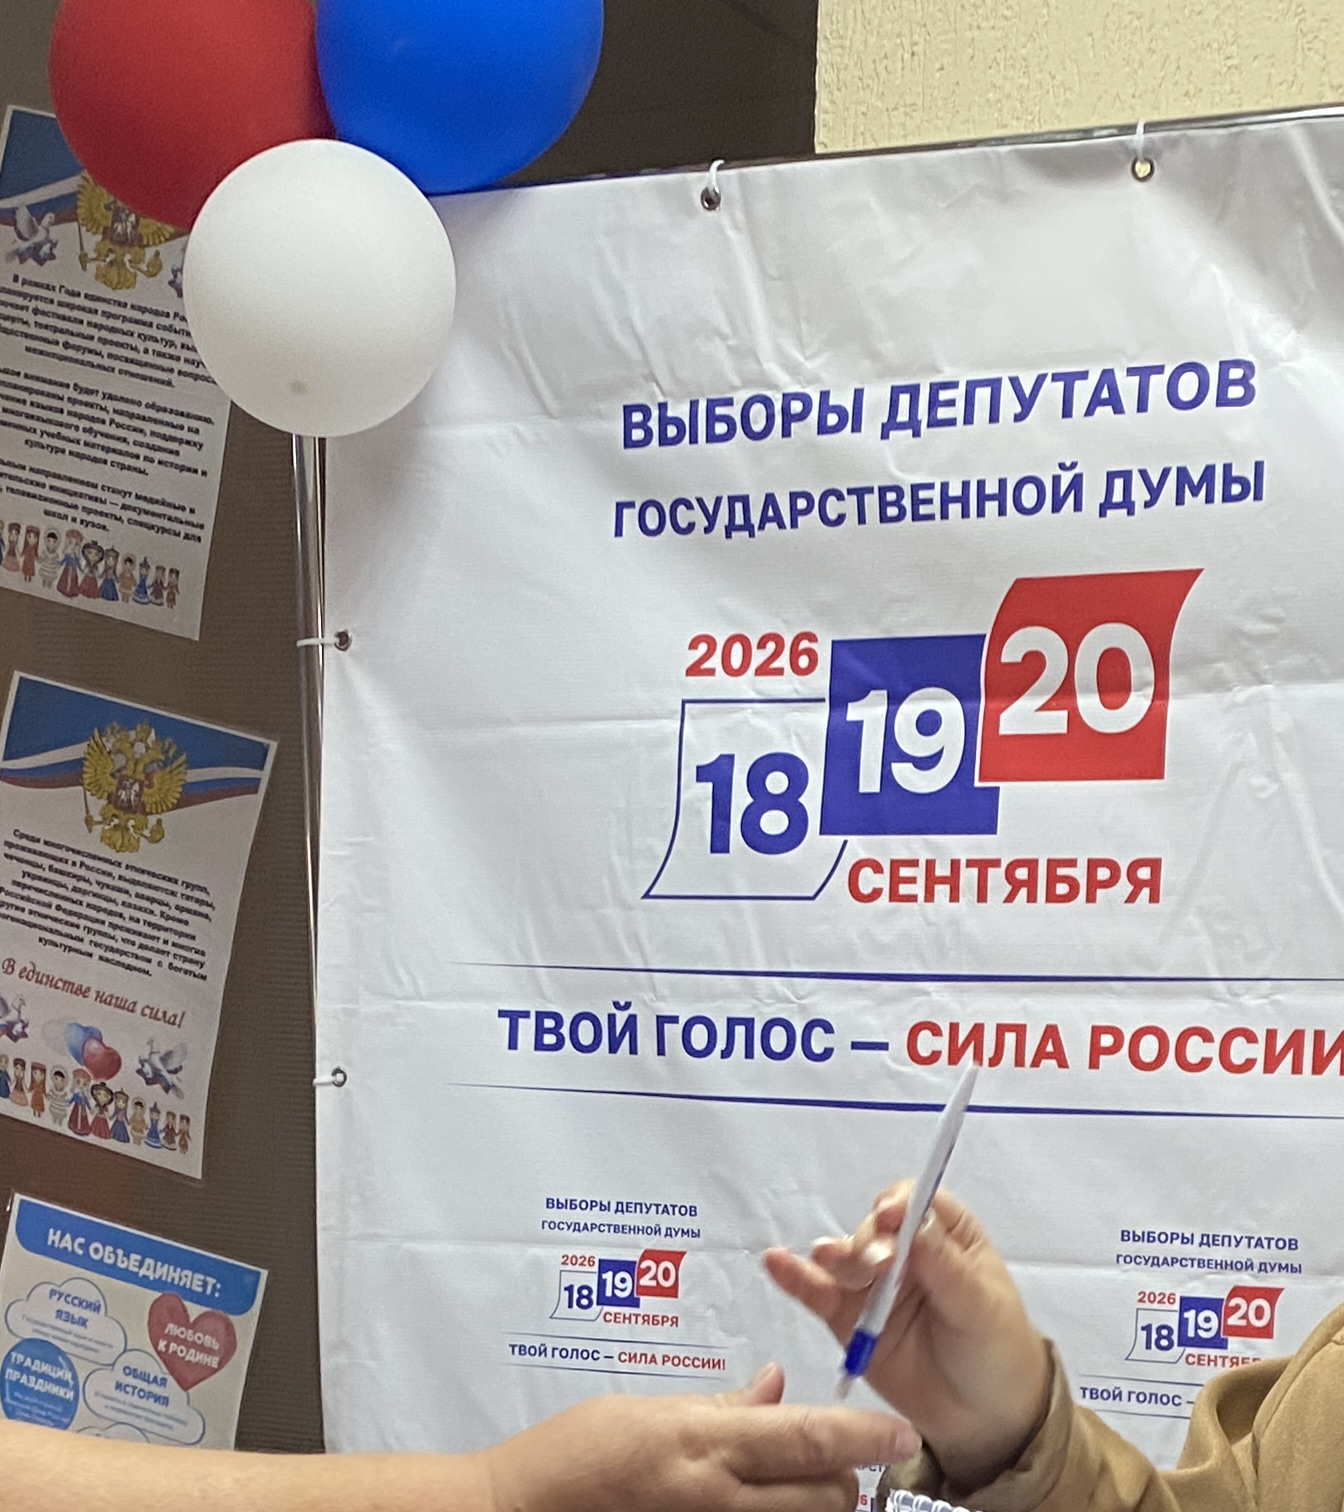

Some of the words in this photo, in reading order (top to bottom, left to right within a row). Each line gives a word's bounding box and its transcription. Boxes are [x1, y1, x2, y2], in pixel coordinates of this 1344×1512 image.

[622, 388, 863, 449] ВЫБОРЫ
[881, 359, 1256, 440] ДЕПУТАТОВ
[614, 462, 1085, 539] ГОСУДАРСТВЕННОЙ
[1099, 461, 1264, 518] ДУМЫ
[685, 632, 819, 677] 2026
[696, 753, 809, 854] 18
[847, 687, 965, 794] 19
[999, 622, 1155, 735] 20
[848, 857, 1162, 904] СЕНТЯБРЯ
[2, 958, 16, 975] В
[19, 961, 91, 998] единстве
[95, 989, 137, 1013] наша
[141, 1005, 186, 1028] сила!
[498, 1000, 638, 1055] ТВОЙ
[656, 1014, 835, 1063] ГОЛОС
[906, 1021, 1070, 1071] СИЛА
[546, 1198, 610, 1212] ВЫБОРЫ
[615, 1201, 697, 1217] ДЕПУТАТОВ
[541, 1220, 661, 1236] ГОСУДАРСТВЕННОЙ
[664, 1227, 701, 1239] ДУМЫ
[1120, 1229, 1194, 1246] ВЫБОРЫ
[1199, 1233, 1299, 1250] ДЕПУТАТОВ
[47, 1227, 85, 1255] НАС
[89, 1242, 222, 1298] ОБЪЕДИНЯЕТ:
[561, 1254, 596, 1267] 2026
[1116, 1254, 1254, 1272] ГОСУДАРСТВЕННОЙ
[1257, 1261, 1302, 1274] ДУМЫ
[564, 1284, 594, 1310] 18
[602, 1270, 633, 1298] 19
[639, 1259, 676, 1287] 20
[1137, 1291, 1176, 1305] 2026
[49, 1288, 101, 1314] РУССКИЙ
[55, 1309, 88, 1328] ЯЗЫК
[603, 1311, 679, 1328] СЕНТЯБРЯ
[1141, 1323, 1174, 1351] 18
[1183, 1309, 1219, 1339] 19
[1227, 1297, 1271, 1328] 20
[165, 1323, 220, 1349] ЛЮБОВЬ
[10, 1351, 73, 1385] ТРАДИЦИИ,
[157, 1340, 166, 1353] К
[169, 1344, 219, 1369] РОДИНЕ
[509, 1343, 547, 1358] ТВОЙ
[551, 1347, 600, 1361] ГОЛОС
[618, 1351, 657, 1365] СИЛА
[662, 1354, 726, 1370] РОССИИ!
[5, 1368, 74, 1401] ПРАЗДНИКИ
[123, 1365, 167, 1387] ОБЩАЯ
[115, 1380, 169, 1407] ИСТОРИЯ
[1080, 1387, 1122, 1402] ТВОЙ
[1128, 1390, 1182, 1407] ГОЛОС
